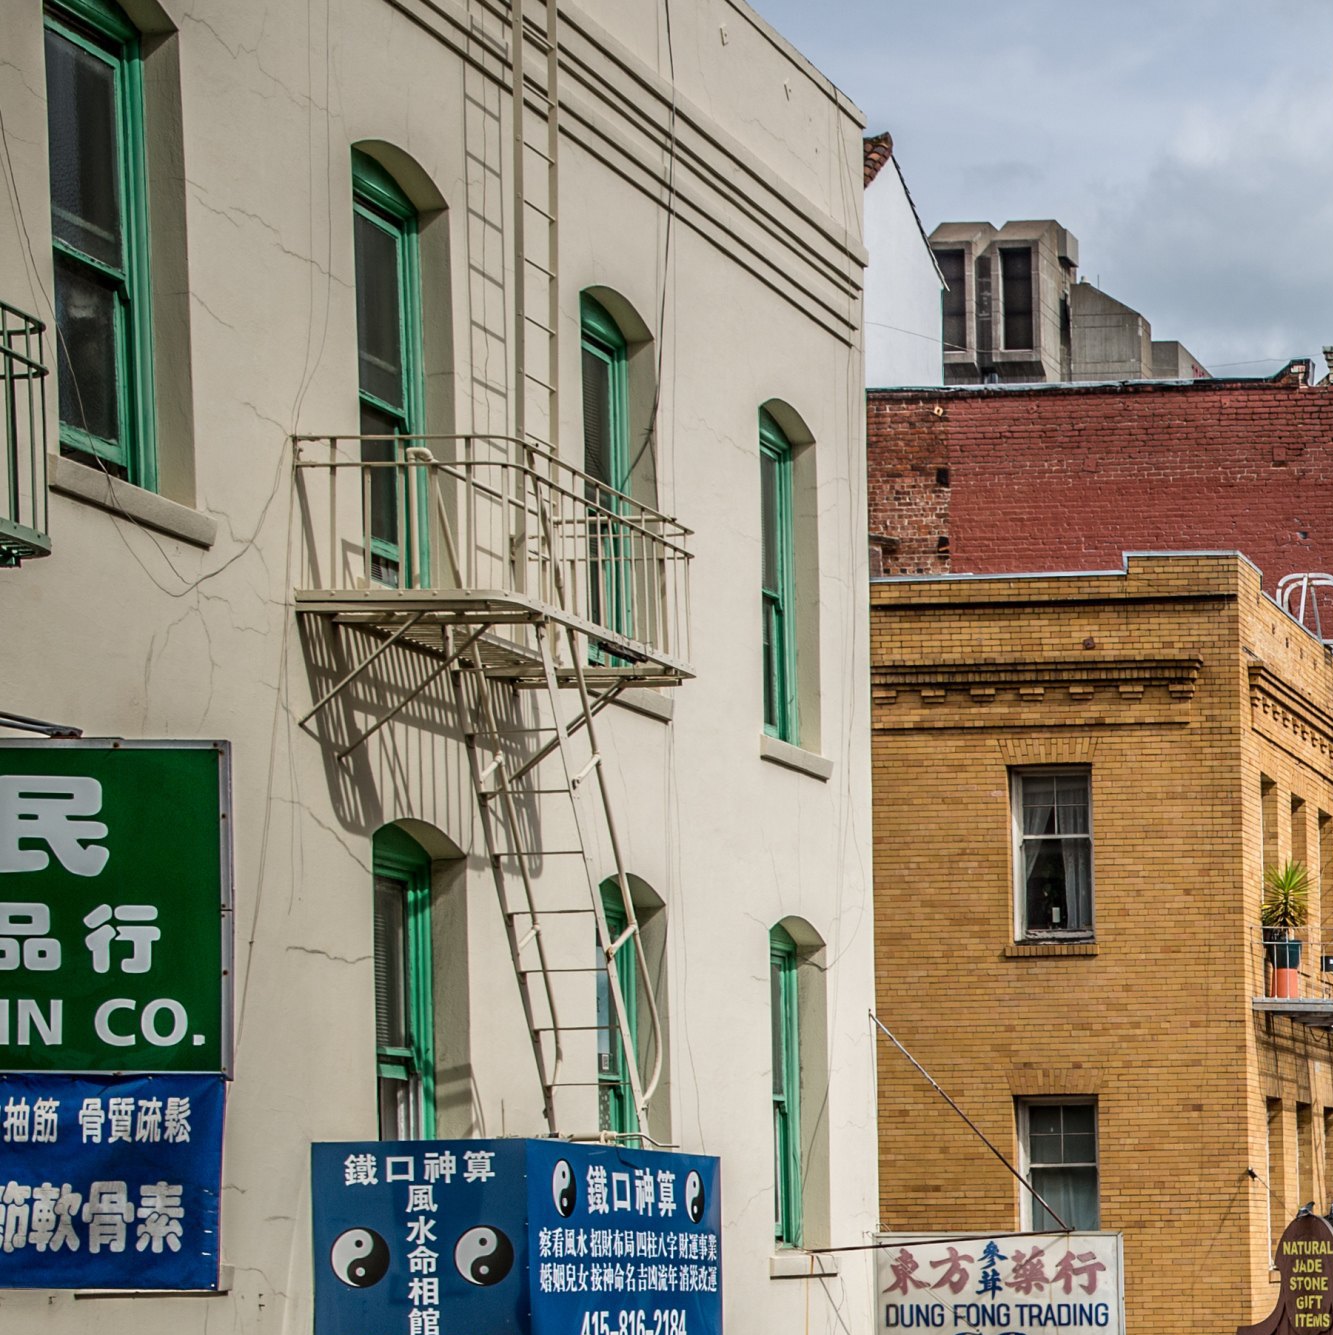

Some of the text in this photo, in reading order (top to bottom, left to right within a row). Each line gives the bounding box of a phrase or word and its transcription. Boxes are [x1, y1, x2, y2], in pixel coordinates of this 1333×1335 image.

[94, 998, 205, 1046] CO.
[79, 1096, 192, 1143] 骨質疏鬆
[344, 1150, 495, 1186] 鐵口神算
[586, 1165, 677, 1217] 鐵口神算
[406, 1185, 439, 1335] 風水命相館
[1283, 1241, 1333, 1255] NATURAL
[1293, 1259, 1322, 1273] JADE
[1290, 1277, 1328, 1291] STONE
[1296, 1295, 1323, 1309] GIFT
[886, 1303, 1109, 1327] DUNG FONG TRADING
[1295, 1314, 1330, 1328] ITEMS
